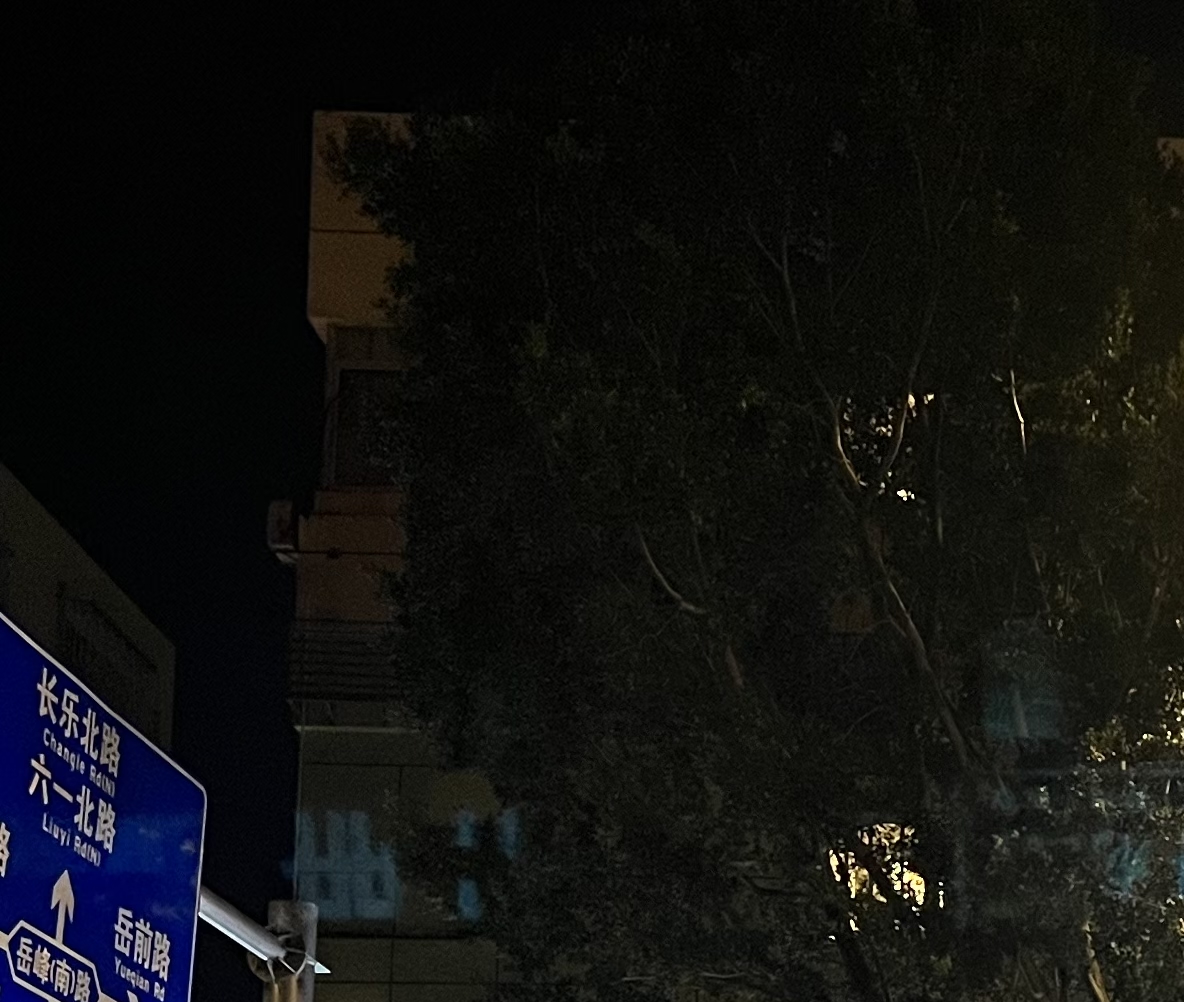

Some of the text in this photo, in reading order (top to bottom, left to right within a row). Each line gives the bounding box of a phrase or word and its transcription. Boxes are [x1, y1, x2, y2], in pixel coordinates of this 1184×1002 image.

[36, 666, 121, 778] 长乐北路
[43, 727, 86, 775] Changle
[28, 753, 116, 854] 六一北路
[42, 812, 71, 847] Liuyi
[114, 906, 171, 982] 岳前路
[114, 956, 166, 1002] Yueqian Rd
